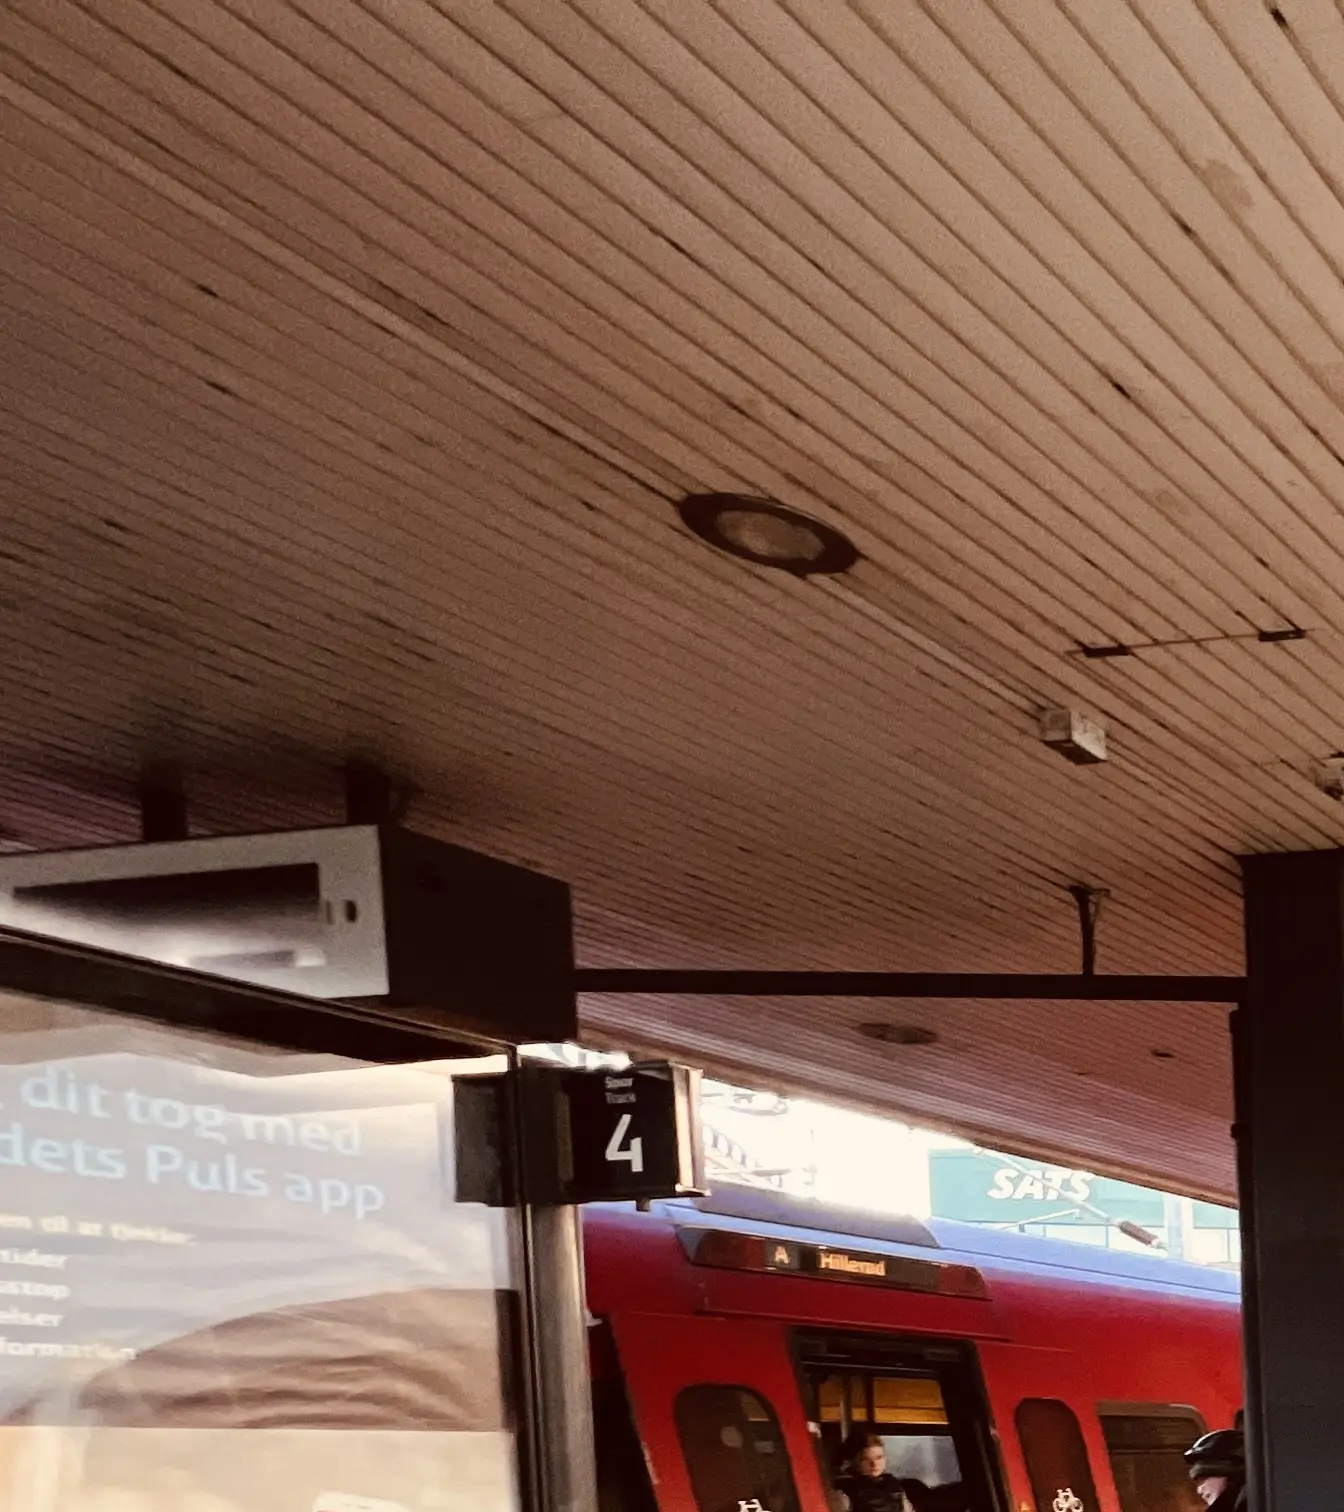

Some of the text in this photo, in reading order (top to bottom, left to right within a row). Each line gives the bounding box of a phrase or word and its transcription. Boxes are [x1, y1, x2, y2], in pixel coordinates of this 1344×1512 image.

[20, 1063, 366, 1156] dit tog med
[604, 1113, 643, 1172] 4
[146, 1144, 270, 1197] Puls
[285, 1171, 386, 1220] app
[986, 1167, 1096, 1201] SATS
